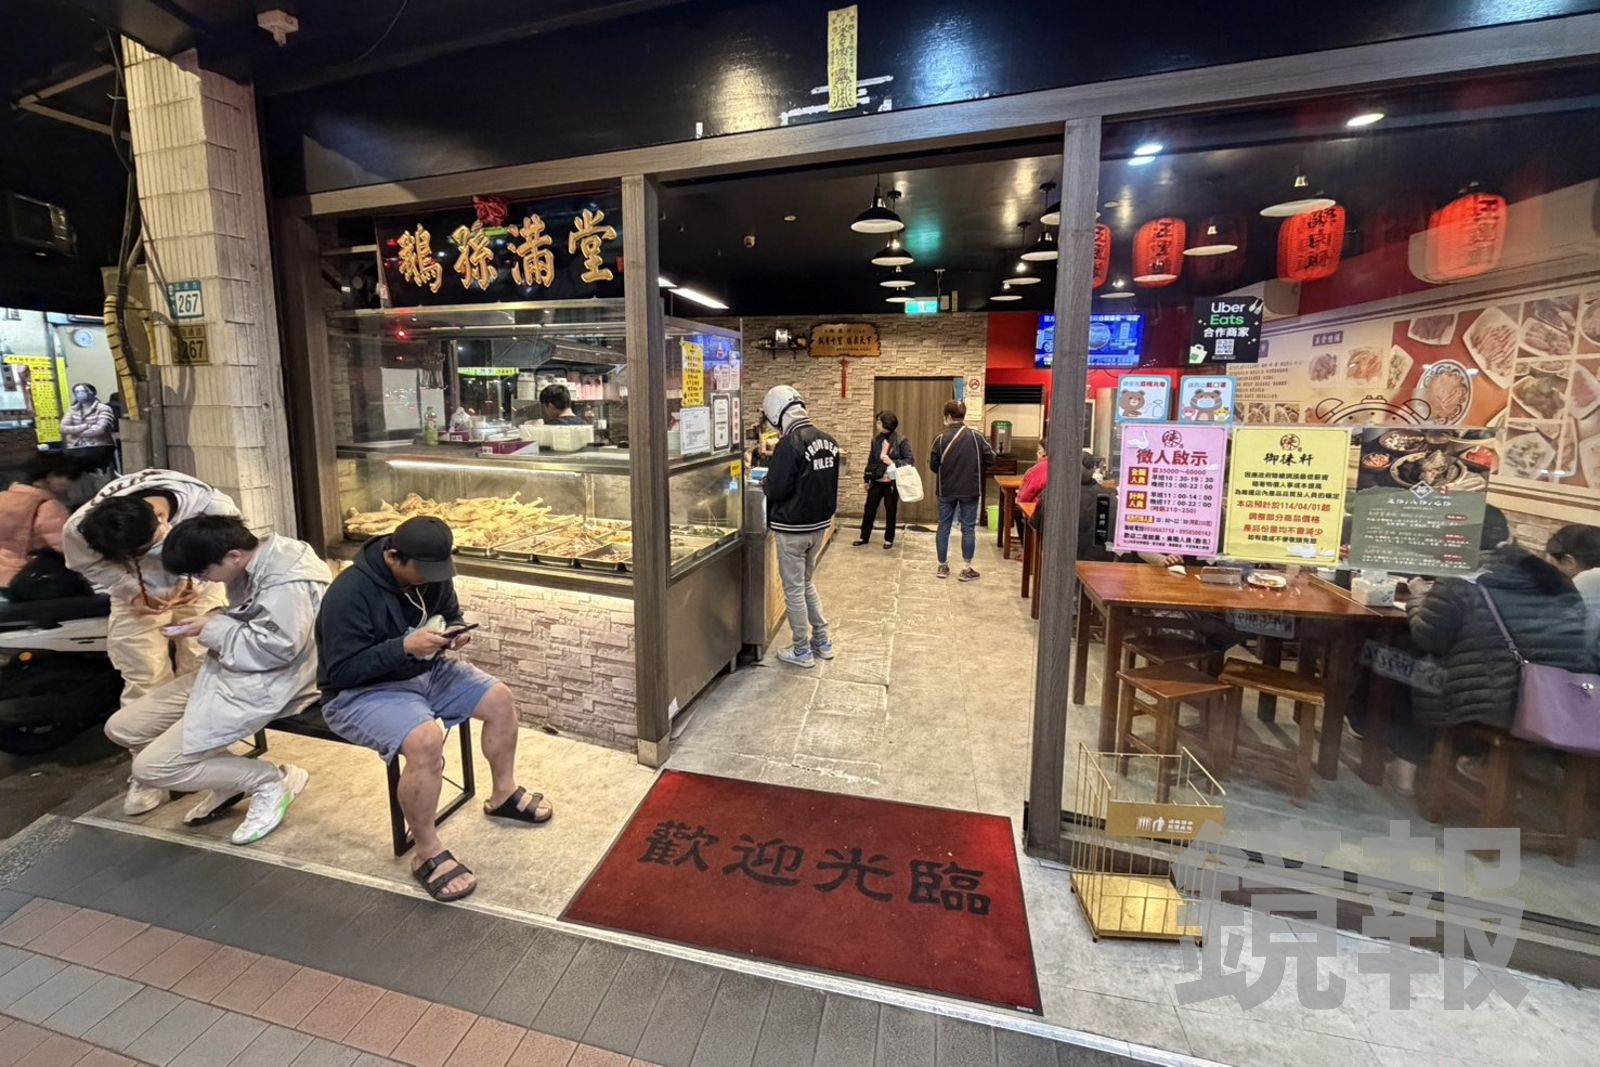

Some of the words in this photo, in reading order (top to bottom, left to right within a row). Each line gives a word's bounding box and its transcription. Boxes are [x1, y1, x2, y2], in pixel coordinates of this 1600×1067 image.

[178, 293, 199, 313] 267
[1211, 302, 1245, 313] Uber
[1210, 314, 1244, 325] Eats
[1203, 327, 1250, 338] 合作商家
[181, 340, 204, 359] 267
[813, 457, 834, 471] RULES
[1136, 448, 1209, 467] 徵人啟示
[637, 818, 992, 916] 歡迎光臨
